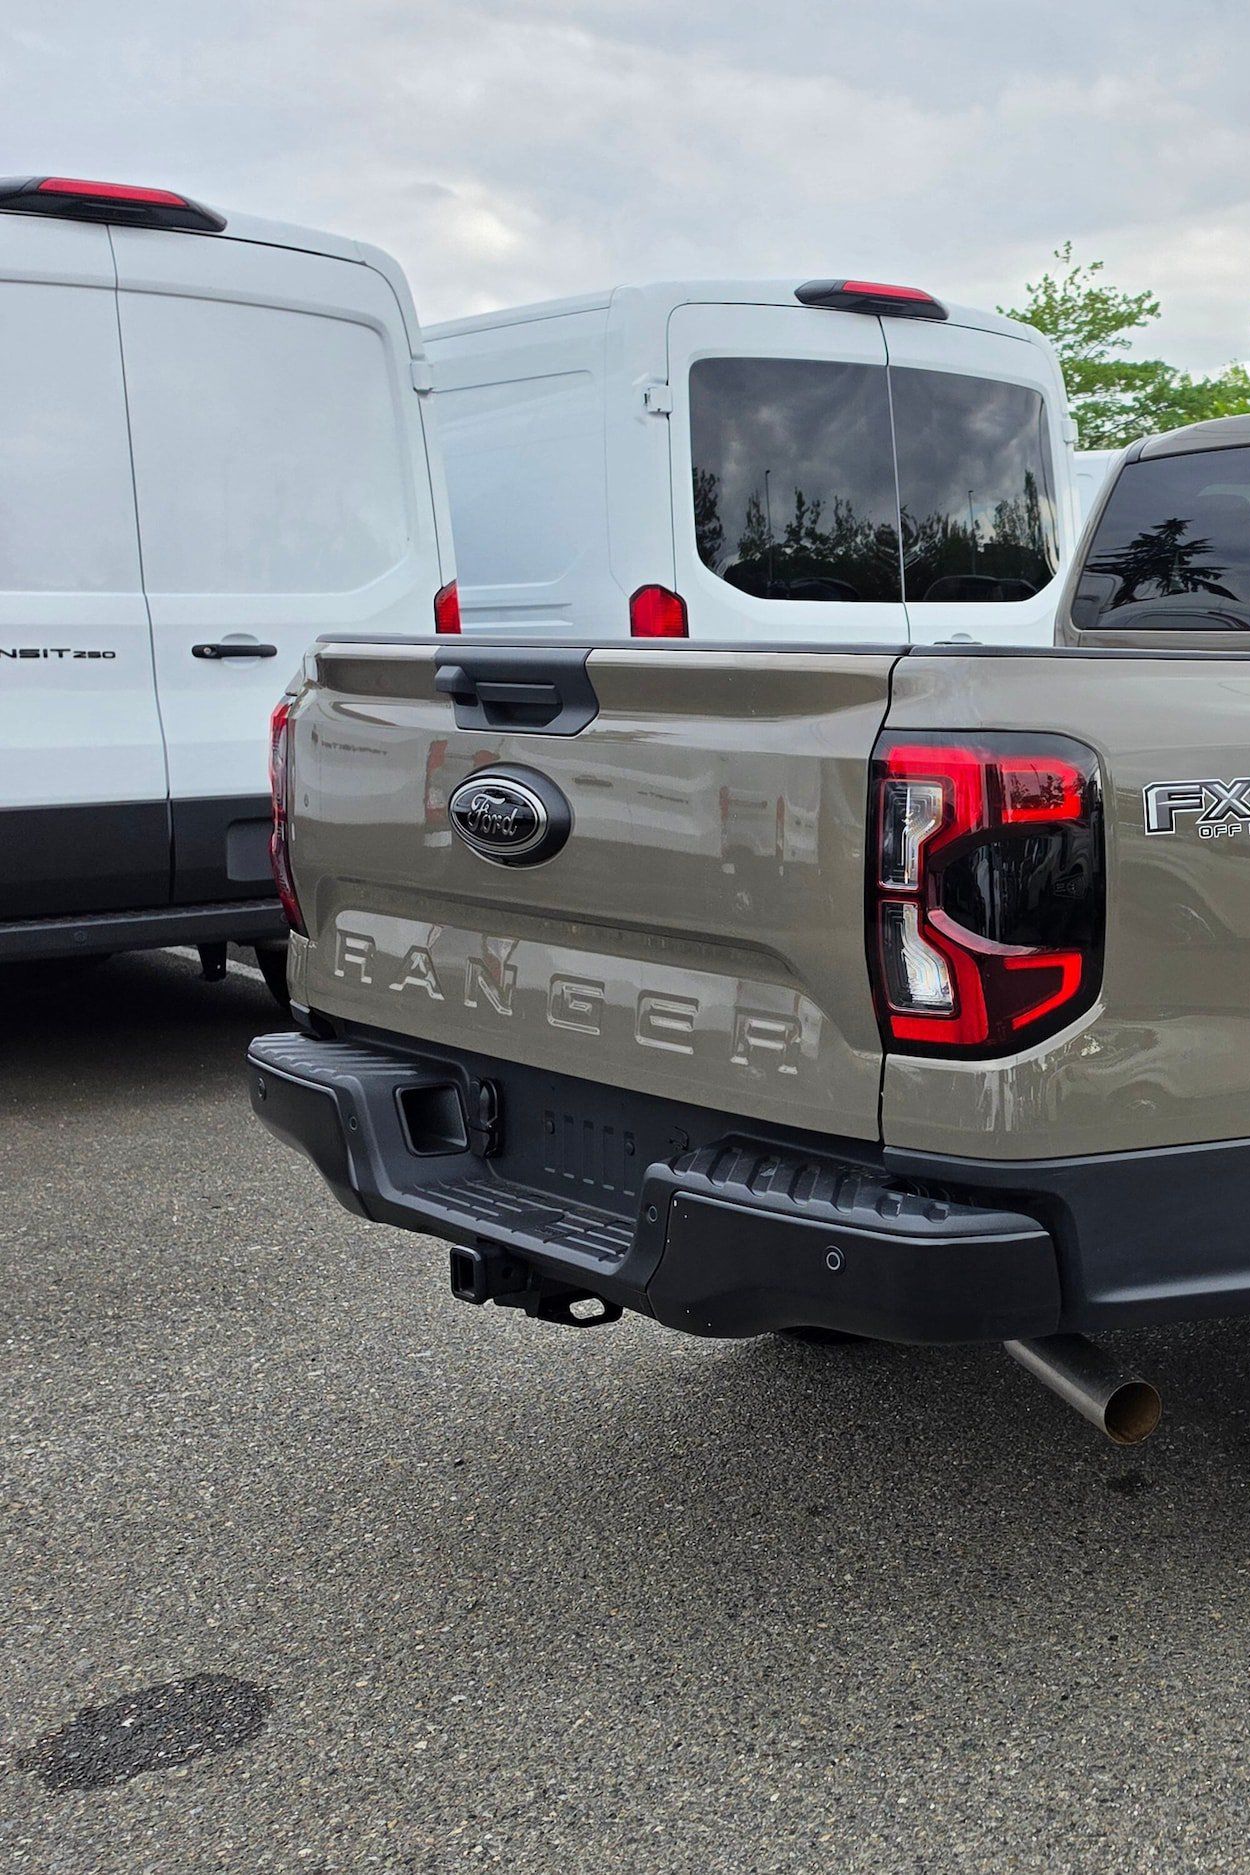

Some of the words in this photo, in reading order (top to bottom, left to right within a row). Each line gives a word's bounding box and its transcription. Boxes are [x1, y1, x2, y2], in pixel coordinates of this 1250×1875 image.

[467, 793, 518, 836] Ford
[1199, 823, 1242, 839] OFF
[334, 928, 802, 1075] RANGER
